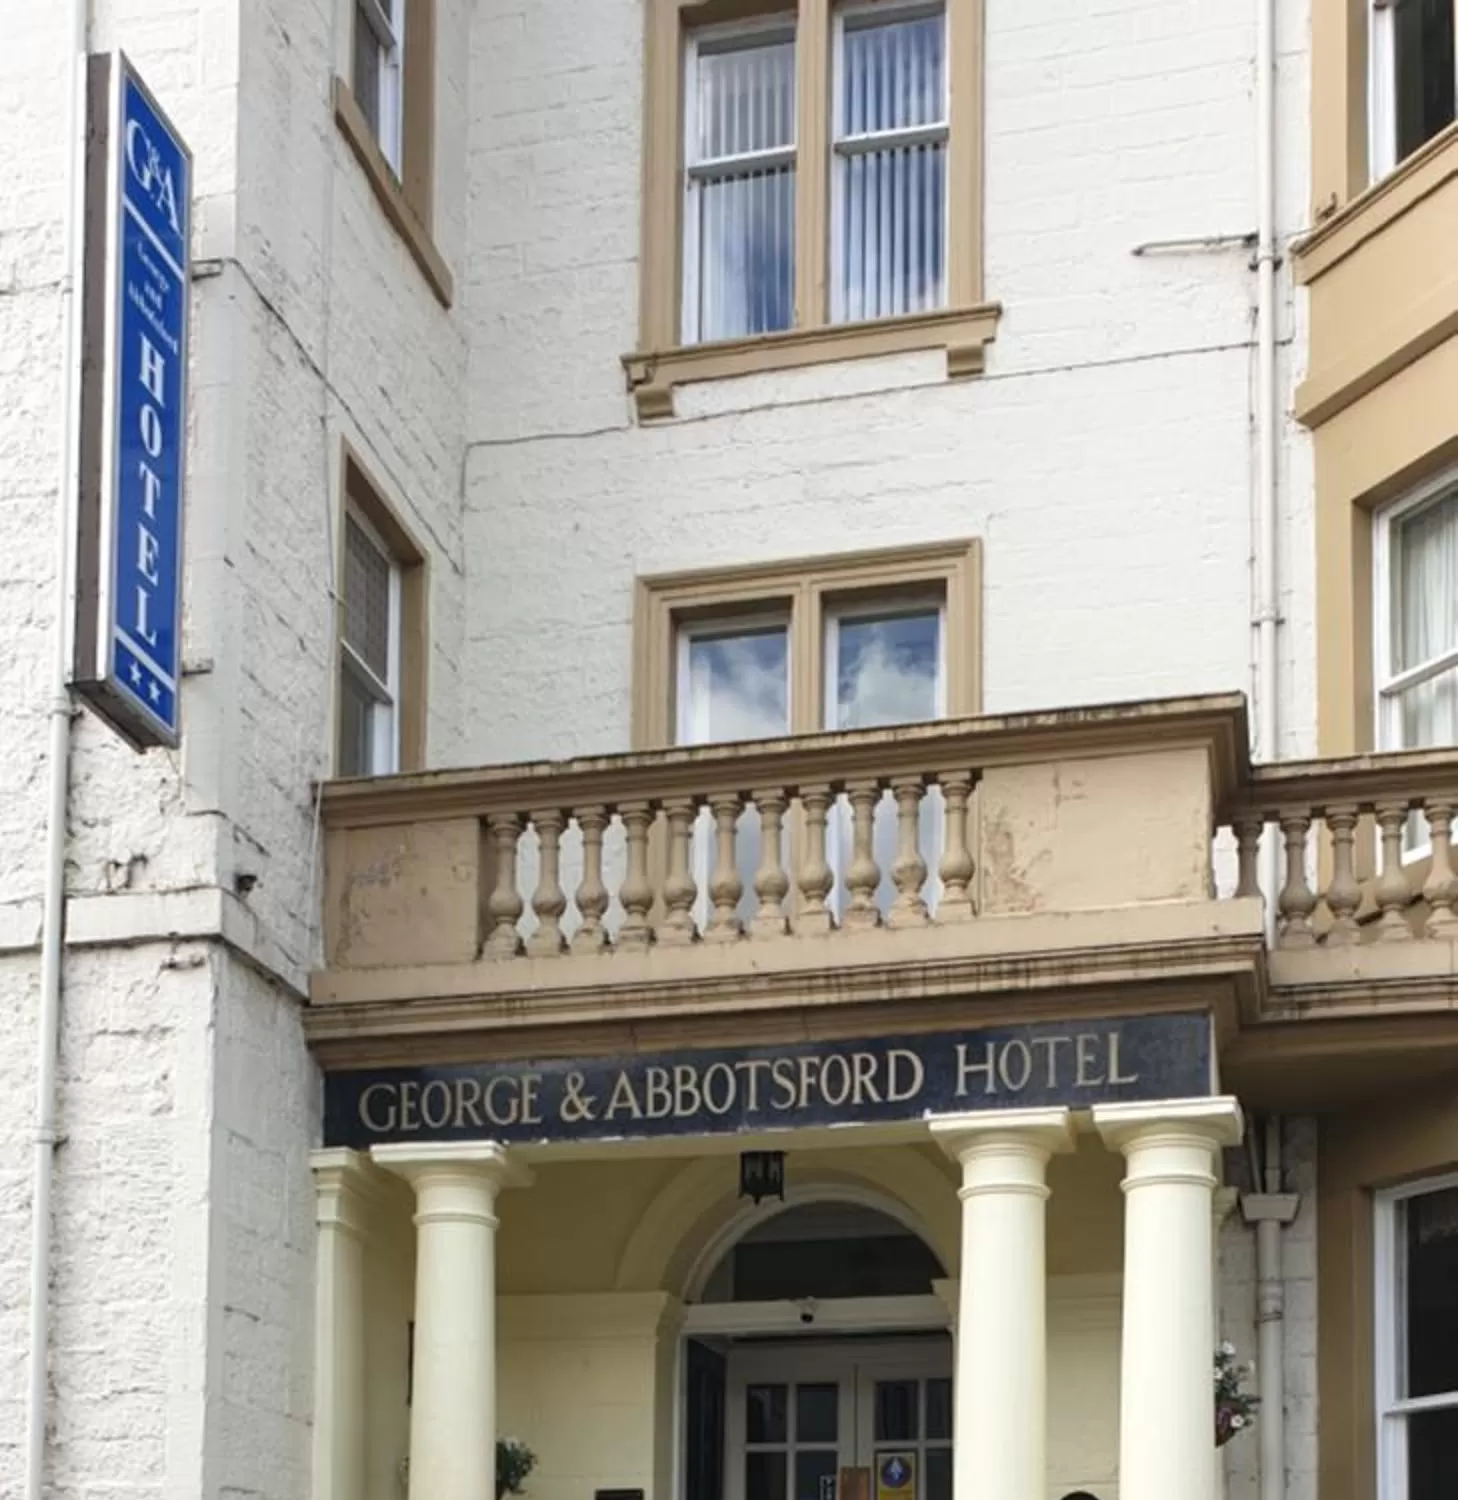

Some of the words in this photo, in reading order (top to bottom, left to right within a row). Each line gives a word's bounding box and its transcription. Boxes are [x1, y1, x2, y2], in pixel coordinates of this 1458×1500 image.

[135, 332, 166, 648] HOTEL
[358, 1073, 543, 1132] GEORGE
[559, 1071, 597, 1122] &
[603, 1041, 925, 1121] ABBOTSFORD
[953, 1031, 1139, 1098] HOTEL
